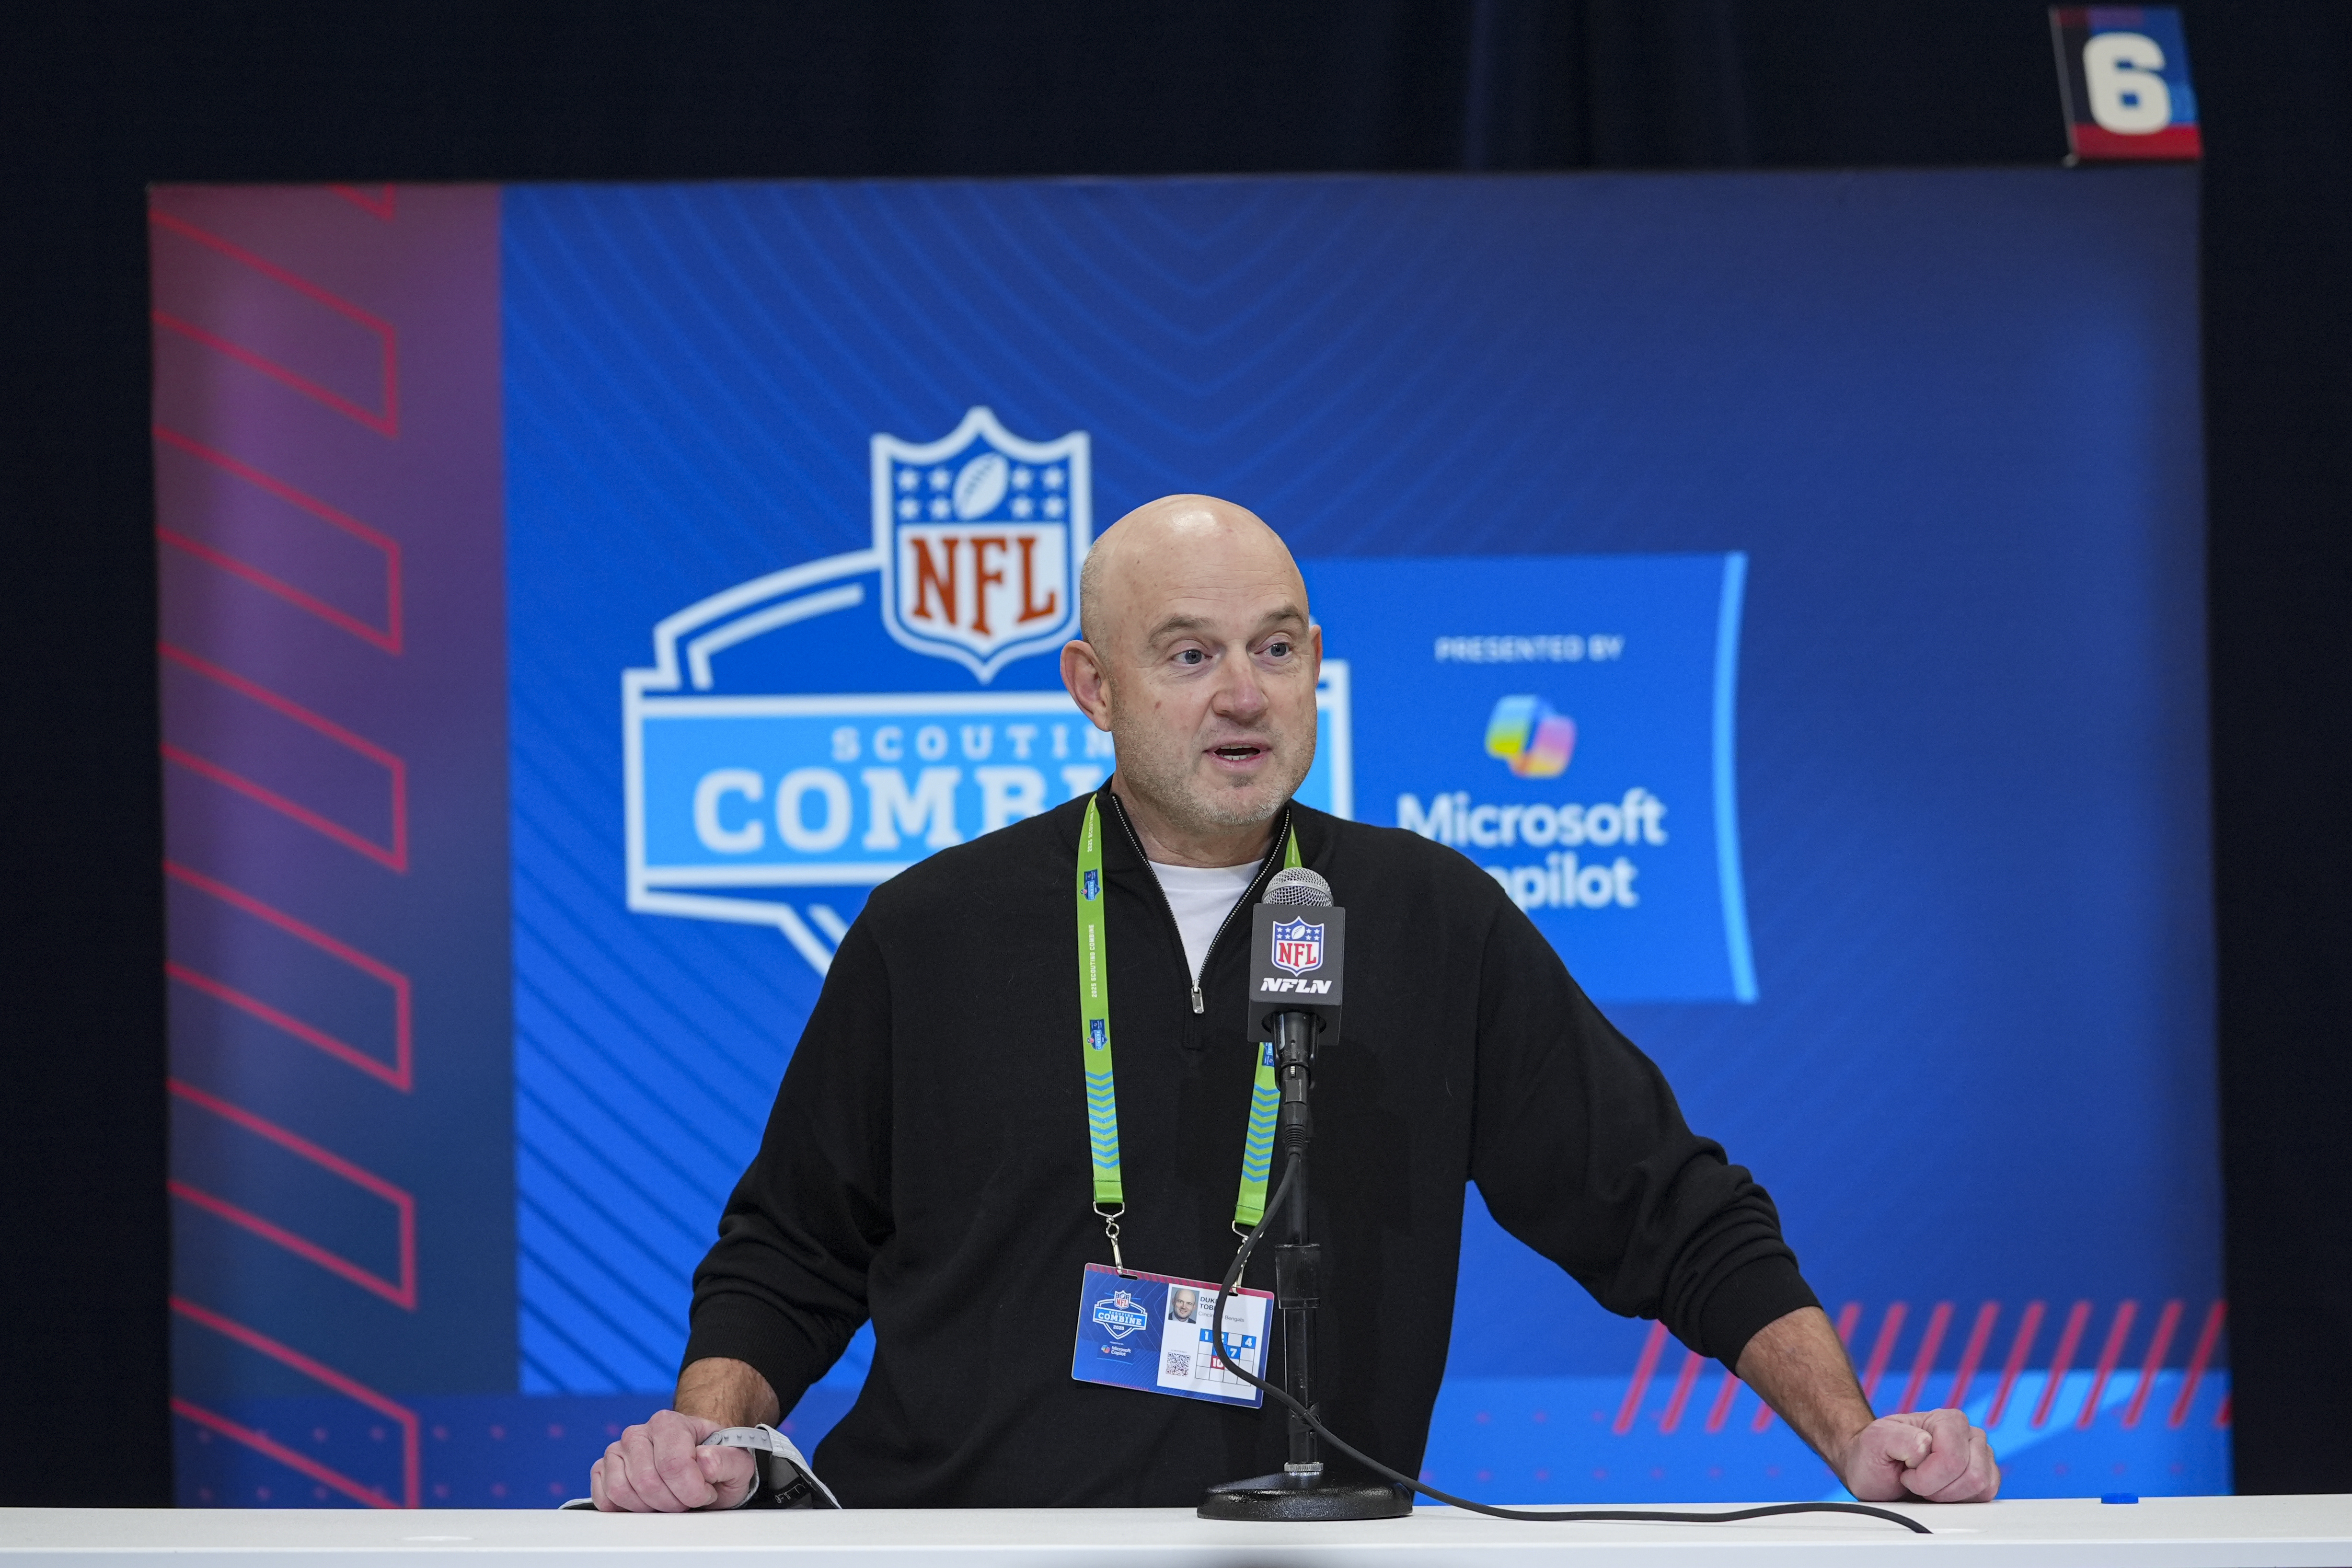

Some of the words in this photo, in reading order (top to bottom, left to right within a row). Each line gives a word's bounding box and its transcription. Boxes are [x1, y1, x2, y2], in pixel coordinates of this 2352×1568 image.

[2083, 31, 2171, 136] 6
[911, 536, 1057, 639] NFL
[1434, 634, 1585, 663] PRESENTED
[1587, 634, 1625, 662] BY
[1396, 788, 1668, 847] Microsoft
[1279, 942, 1317, 967] NFL
[1260, 977, 1332, 994] NFLN
[1116, 1298, 1127, 1307] NFL
[1098, 1312, 1142, 1326] COMBINE
[1204, 1331, 1209, 1340] 1
[1245, 1337, 1252, 1347] 4
[1230, 1348, 1237, 1357] 7
[1212, 1358, 1224, 1368] 10
